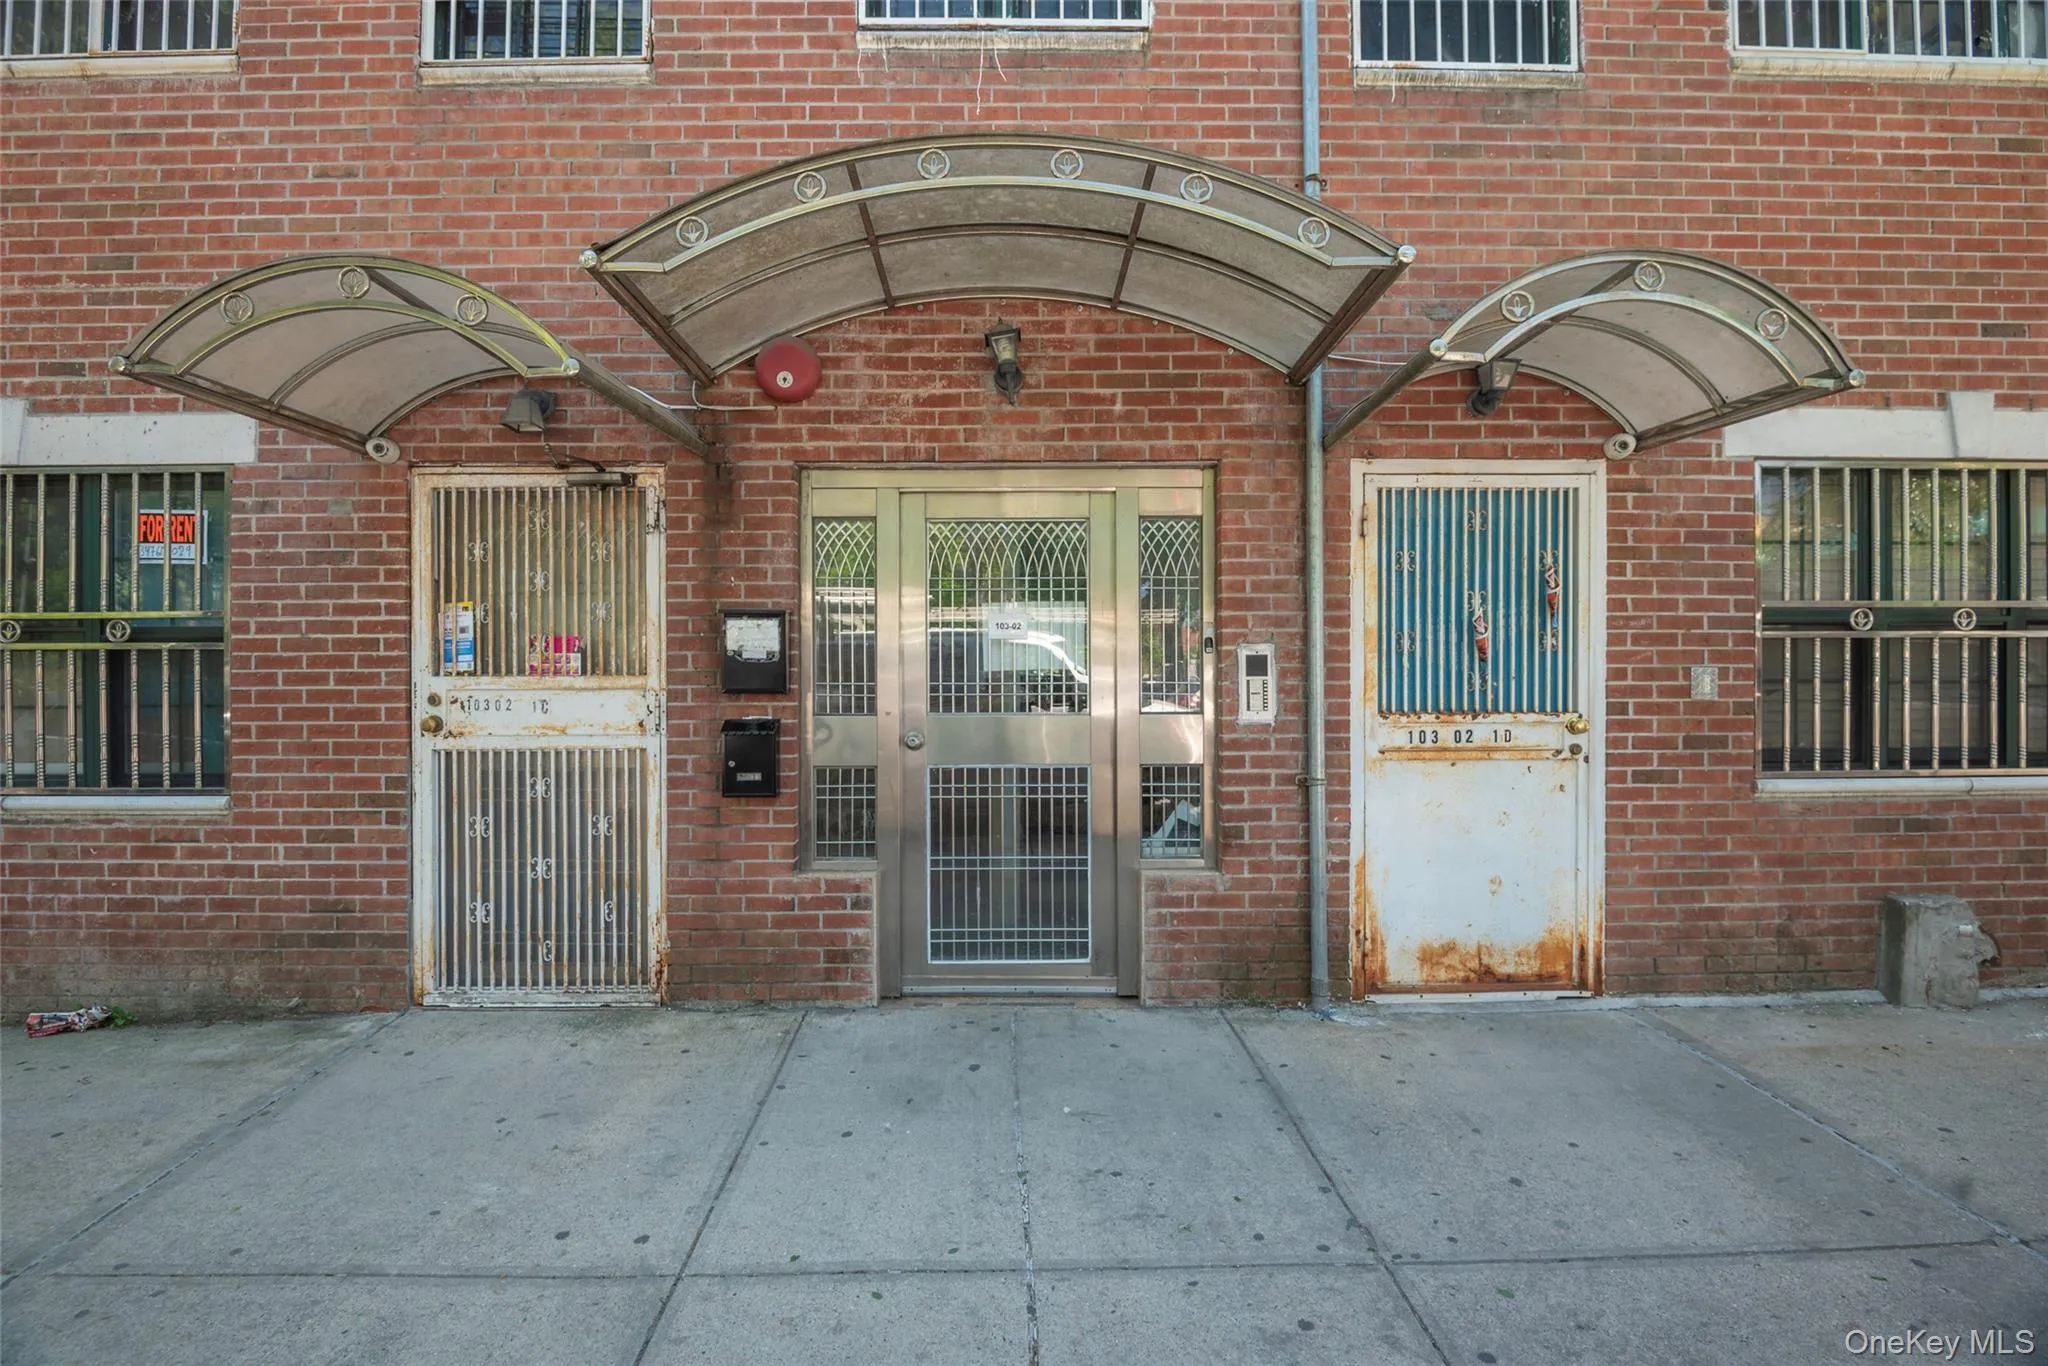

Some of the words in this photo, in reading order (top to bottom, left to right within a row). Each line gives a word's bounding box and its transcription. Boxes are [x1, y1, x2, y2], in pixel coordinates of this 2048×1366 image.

[139, 514, 164, 542] FOR
[995, 622, 1022, 630] 103-02
[1408, 729, 1439, 744] 103
[1454, 729, 1474, 744] 02
[1492, 729, 1512, 743] 1D
